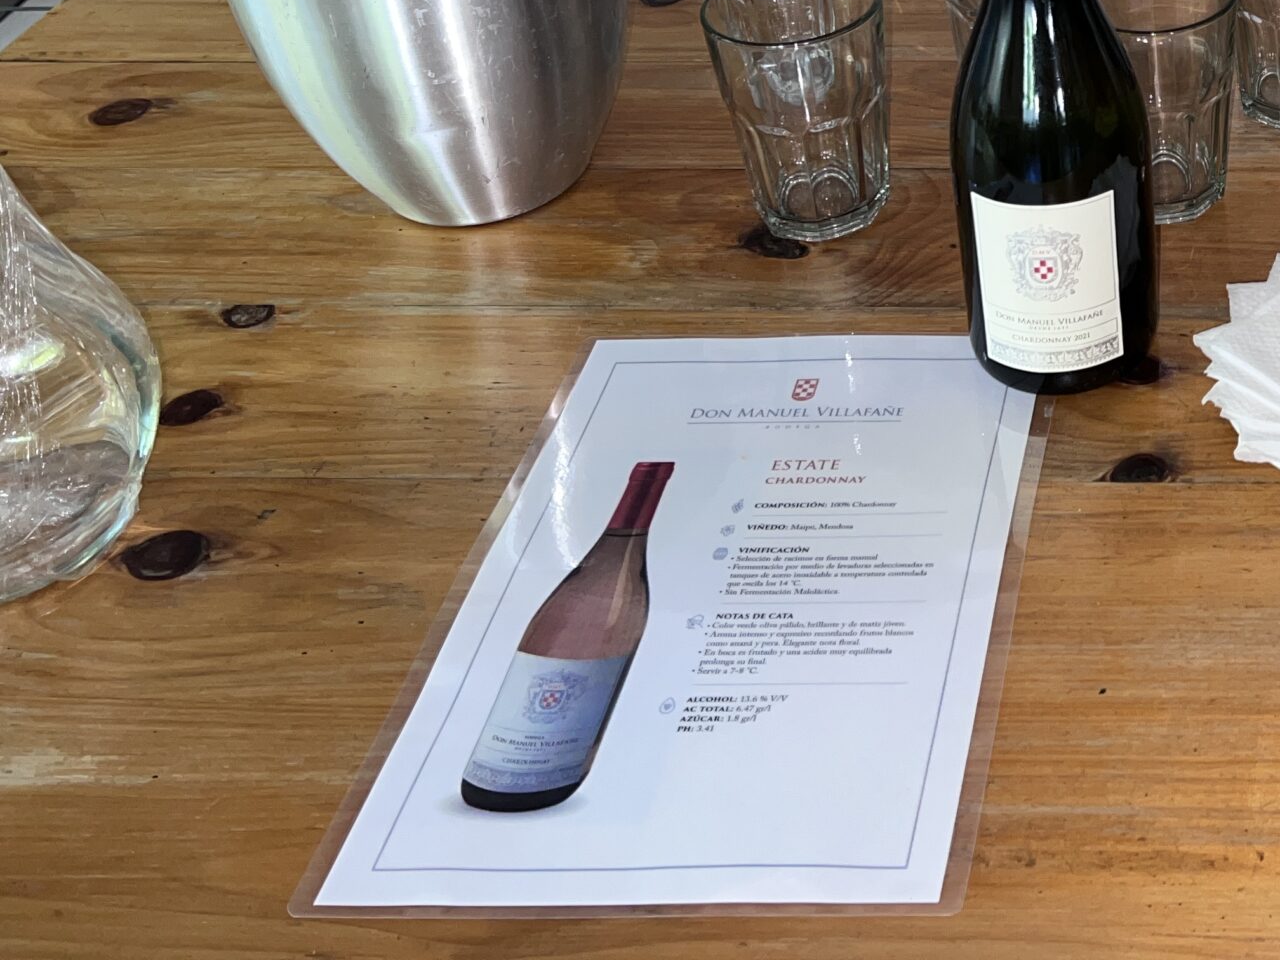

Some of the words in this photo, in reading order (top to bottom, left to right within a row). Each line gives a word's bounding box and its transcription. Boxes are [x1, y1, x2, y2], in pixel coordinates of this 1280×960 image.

[995, 311, 1015, 322] DON
[1017, 316, 1054, 326] MANUEL
[1058, 309, 1104, 325] VILLAFAÑE
[1012, 334, 1072, 344] CHARDONNAY
[1074, 332, 1091, 341] 2021
[690, 408, 733, 419] DON
[737, 407, 809, 418] MANUEL
[817, 405, 904, 417] VILLAFAÑE
[771, 459, 841, 471] ESTATE
[765, 475, 867, 485] CHARDONNAY
[754, 501, 828, 509] COMPOSICIÓN:
[852, 501, 897, 509] Chardonnay
[747, 522, 788, 531] VIÑEDO:
[818, 522, 854, 530] Mendoza
[736, 554, 771, 562] Selección
[773, 554, 782, 562] de
[826, 553, 848, 561] forma
[840, 571, 885, 579] temperatura
[726, 581, 741, 589] que
[807, 620, 839, 628] brillante
[710, 630, 737, 638] Aroma
[776, 631, 812, 639] expresivo
[782, 639, 817, 647] Elegante
[704, 648, 716, 656] En
[748, 648, 777, 656] frutado
[848, 648, 892, 656] equilibrada
[699, 658, 735, 666] prolonga
[697, 667, 721, 675] Servir
[686, 695, 738, 703] ALCOHOL:
[740, 695, 758, 703] 13.6
[771, 694, 789, 702] V/V
[700, 705, 734, 713] TOTAL:
[735, 705, 754, 713] 6.47
[680, 714, 724, 723] AZÚCAR:
